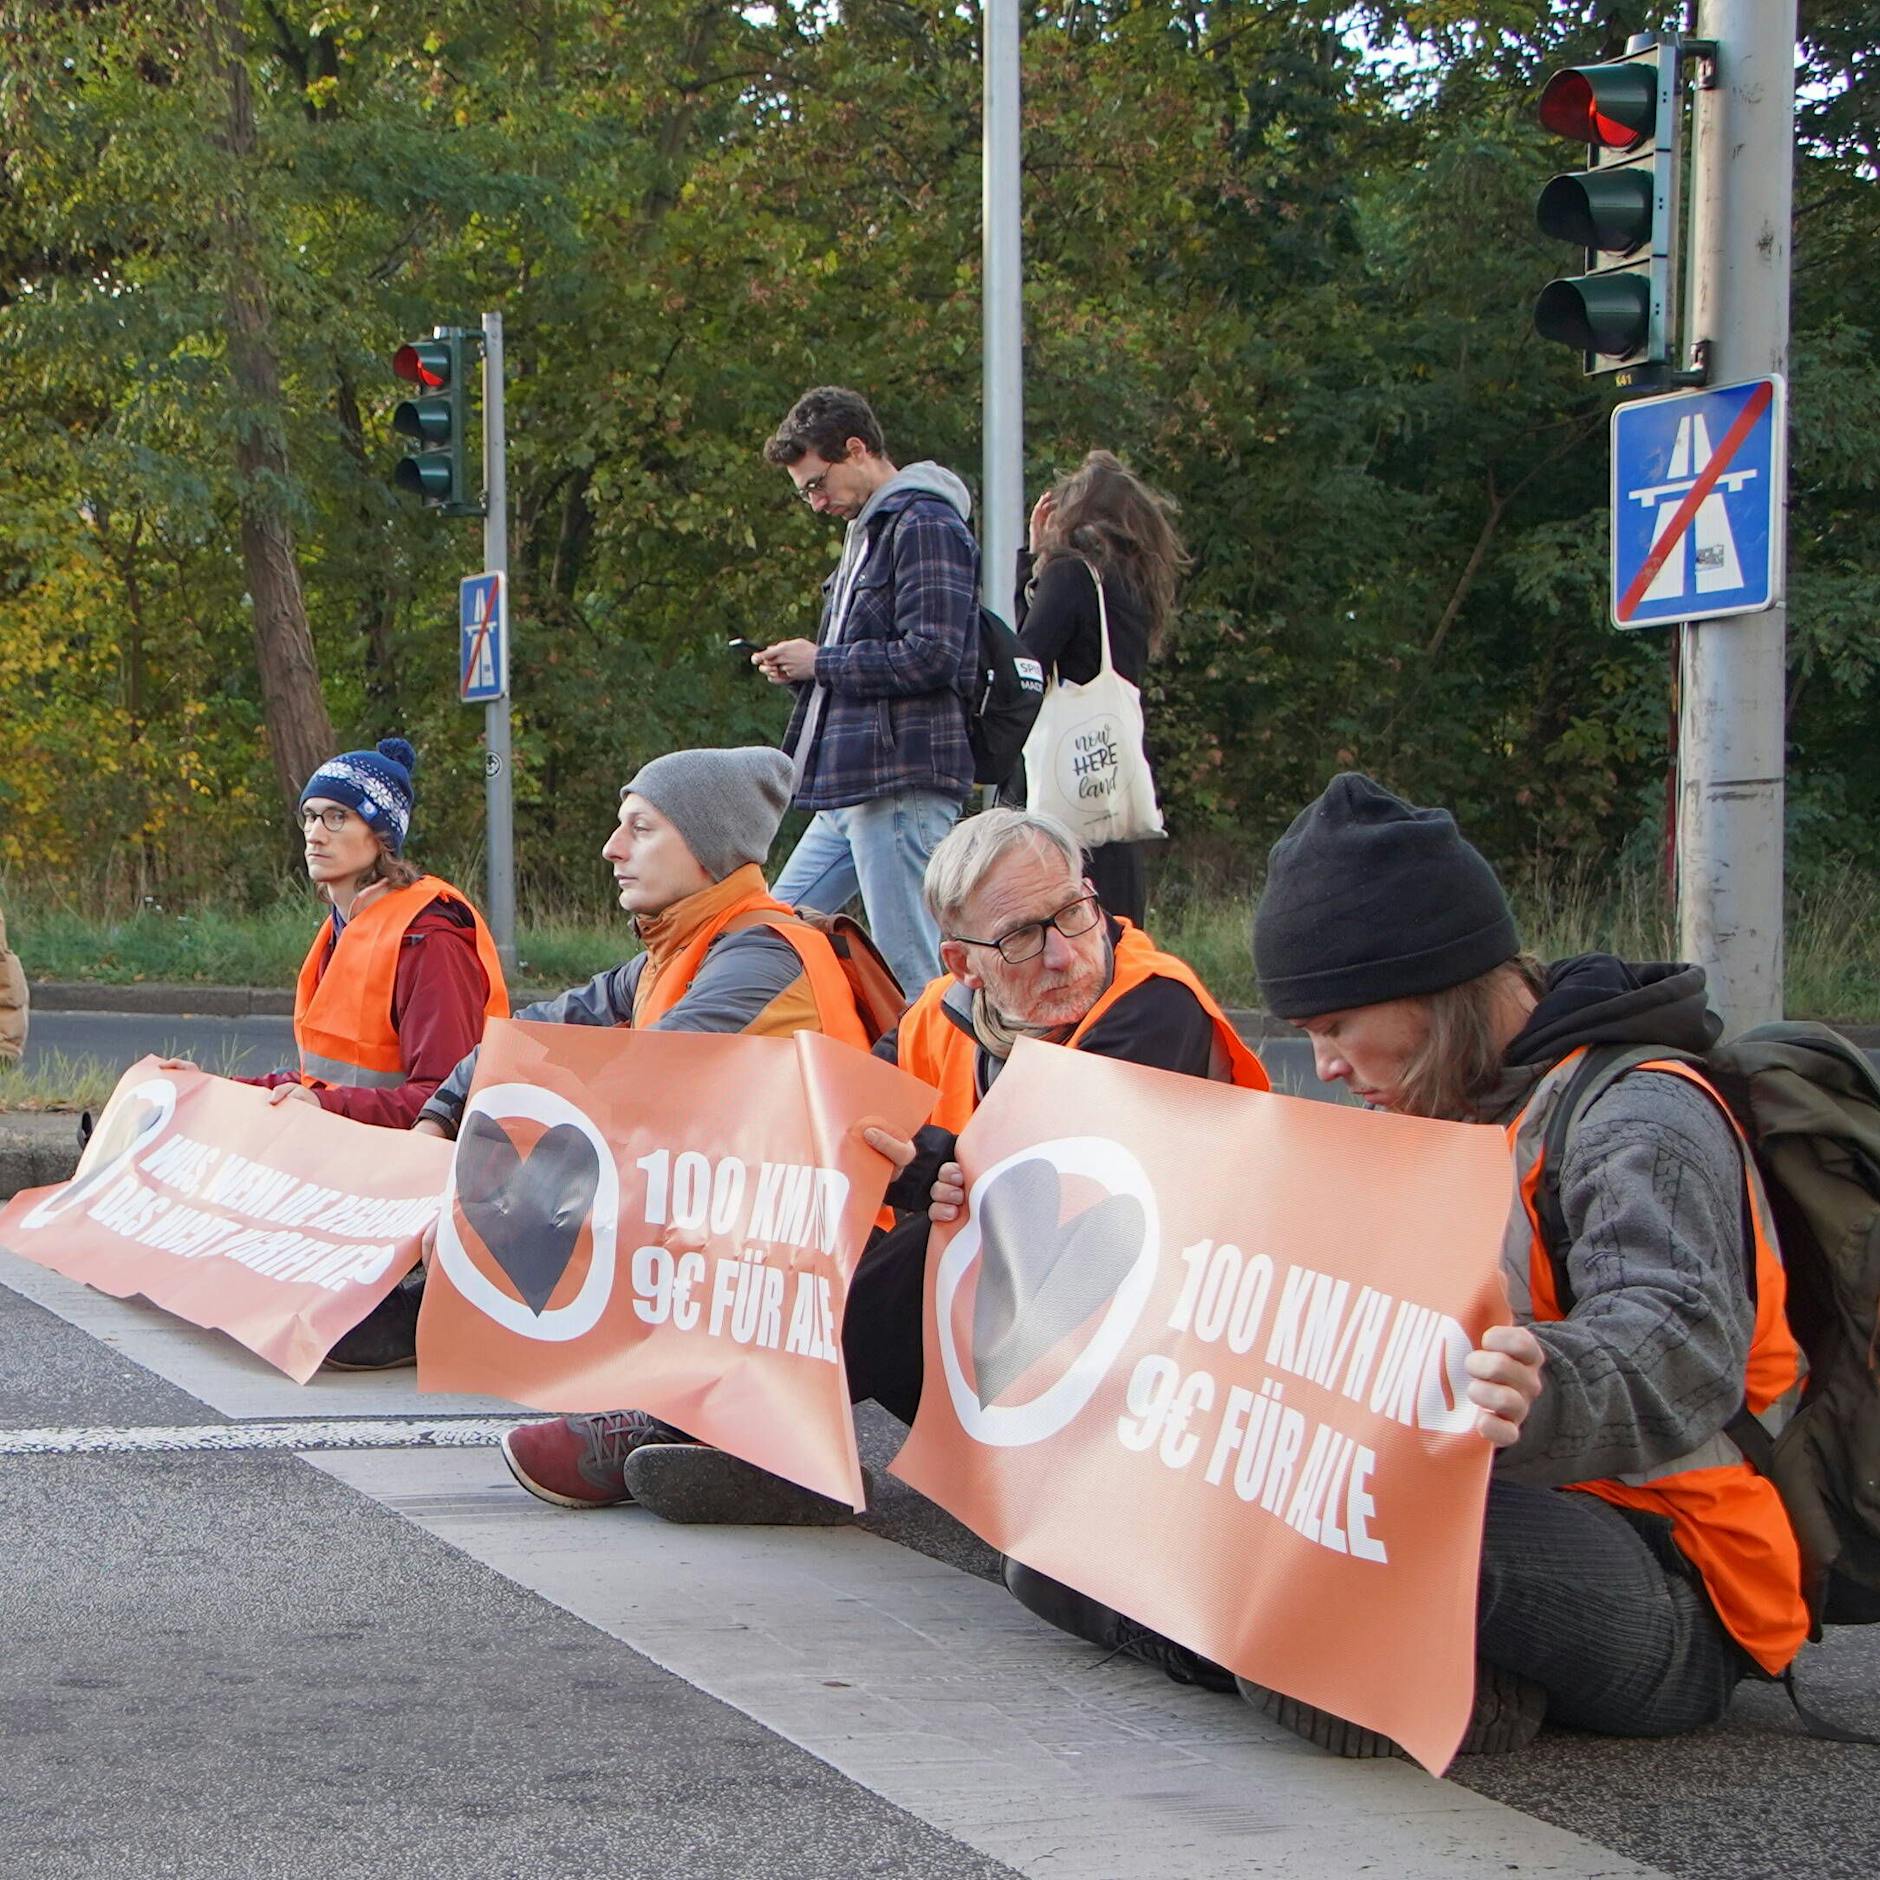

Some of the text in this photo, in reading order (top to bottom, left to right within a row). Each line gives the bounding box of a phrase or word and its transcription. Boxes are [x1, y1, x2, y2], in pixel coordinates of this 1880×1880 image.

[1073, 743, 1118, 776] HERE
[1079, 766, 1118, 799] land
[87, 1175, 172, 1237] DAS
[636, 1149, 747, 1236] 100
[631, 1245, 705, 1331] 9€
[708, 1248, 785, 1349] FÜR
[1168, 1239, 1480, 1434] 100 KM/H UND
[1117, 1354, 1389, 1564] 9€ FÜR ALLE
